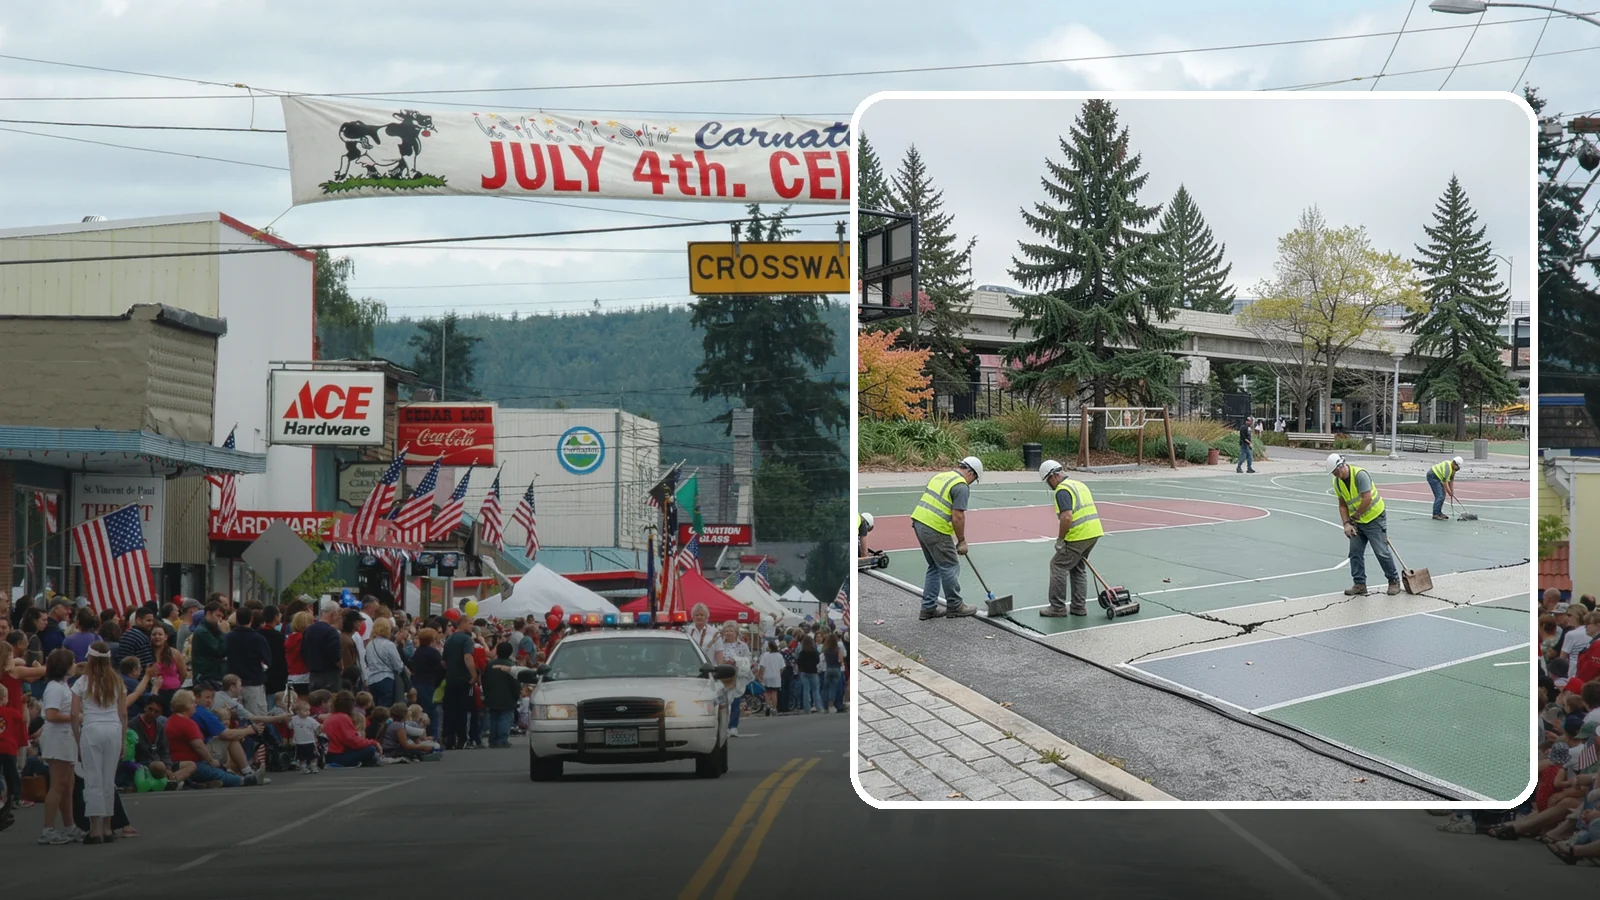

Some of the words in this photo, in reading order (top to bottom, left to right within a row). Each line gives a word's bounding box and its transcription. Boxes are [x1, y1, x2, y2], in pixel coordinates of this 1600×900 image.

[481, 140, 604, 192] JULY
[632, 150, 746, 198] 4th.
[696, 254, 850, 279] CROSSWA
[282, 380, 373, 419] ACE
[405, 409, 452, 421] CEDAR
[283, 421, 370, 436] Hardware
[353, 467, 384, 480] Simpl
[83, 485, 93, 494] St.
[95, 485, 124, 495] Vincent
[126, 486, 135, 495] de
[137, 486, 155, 495] Paul
[688, 526, 741, 535] CRNATION
[699, 535, 730, 543] GLASS
